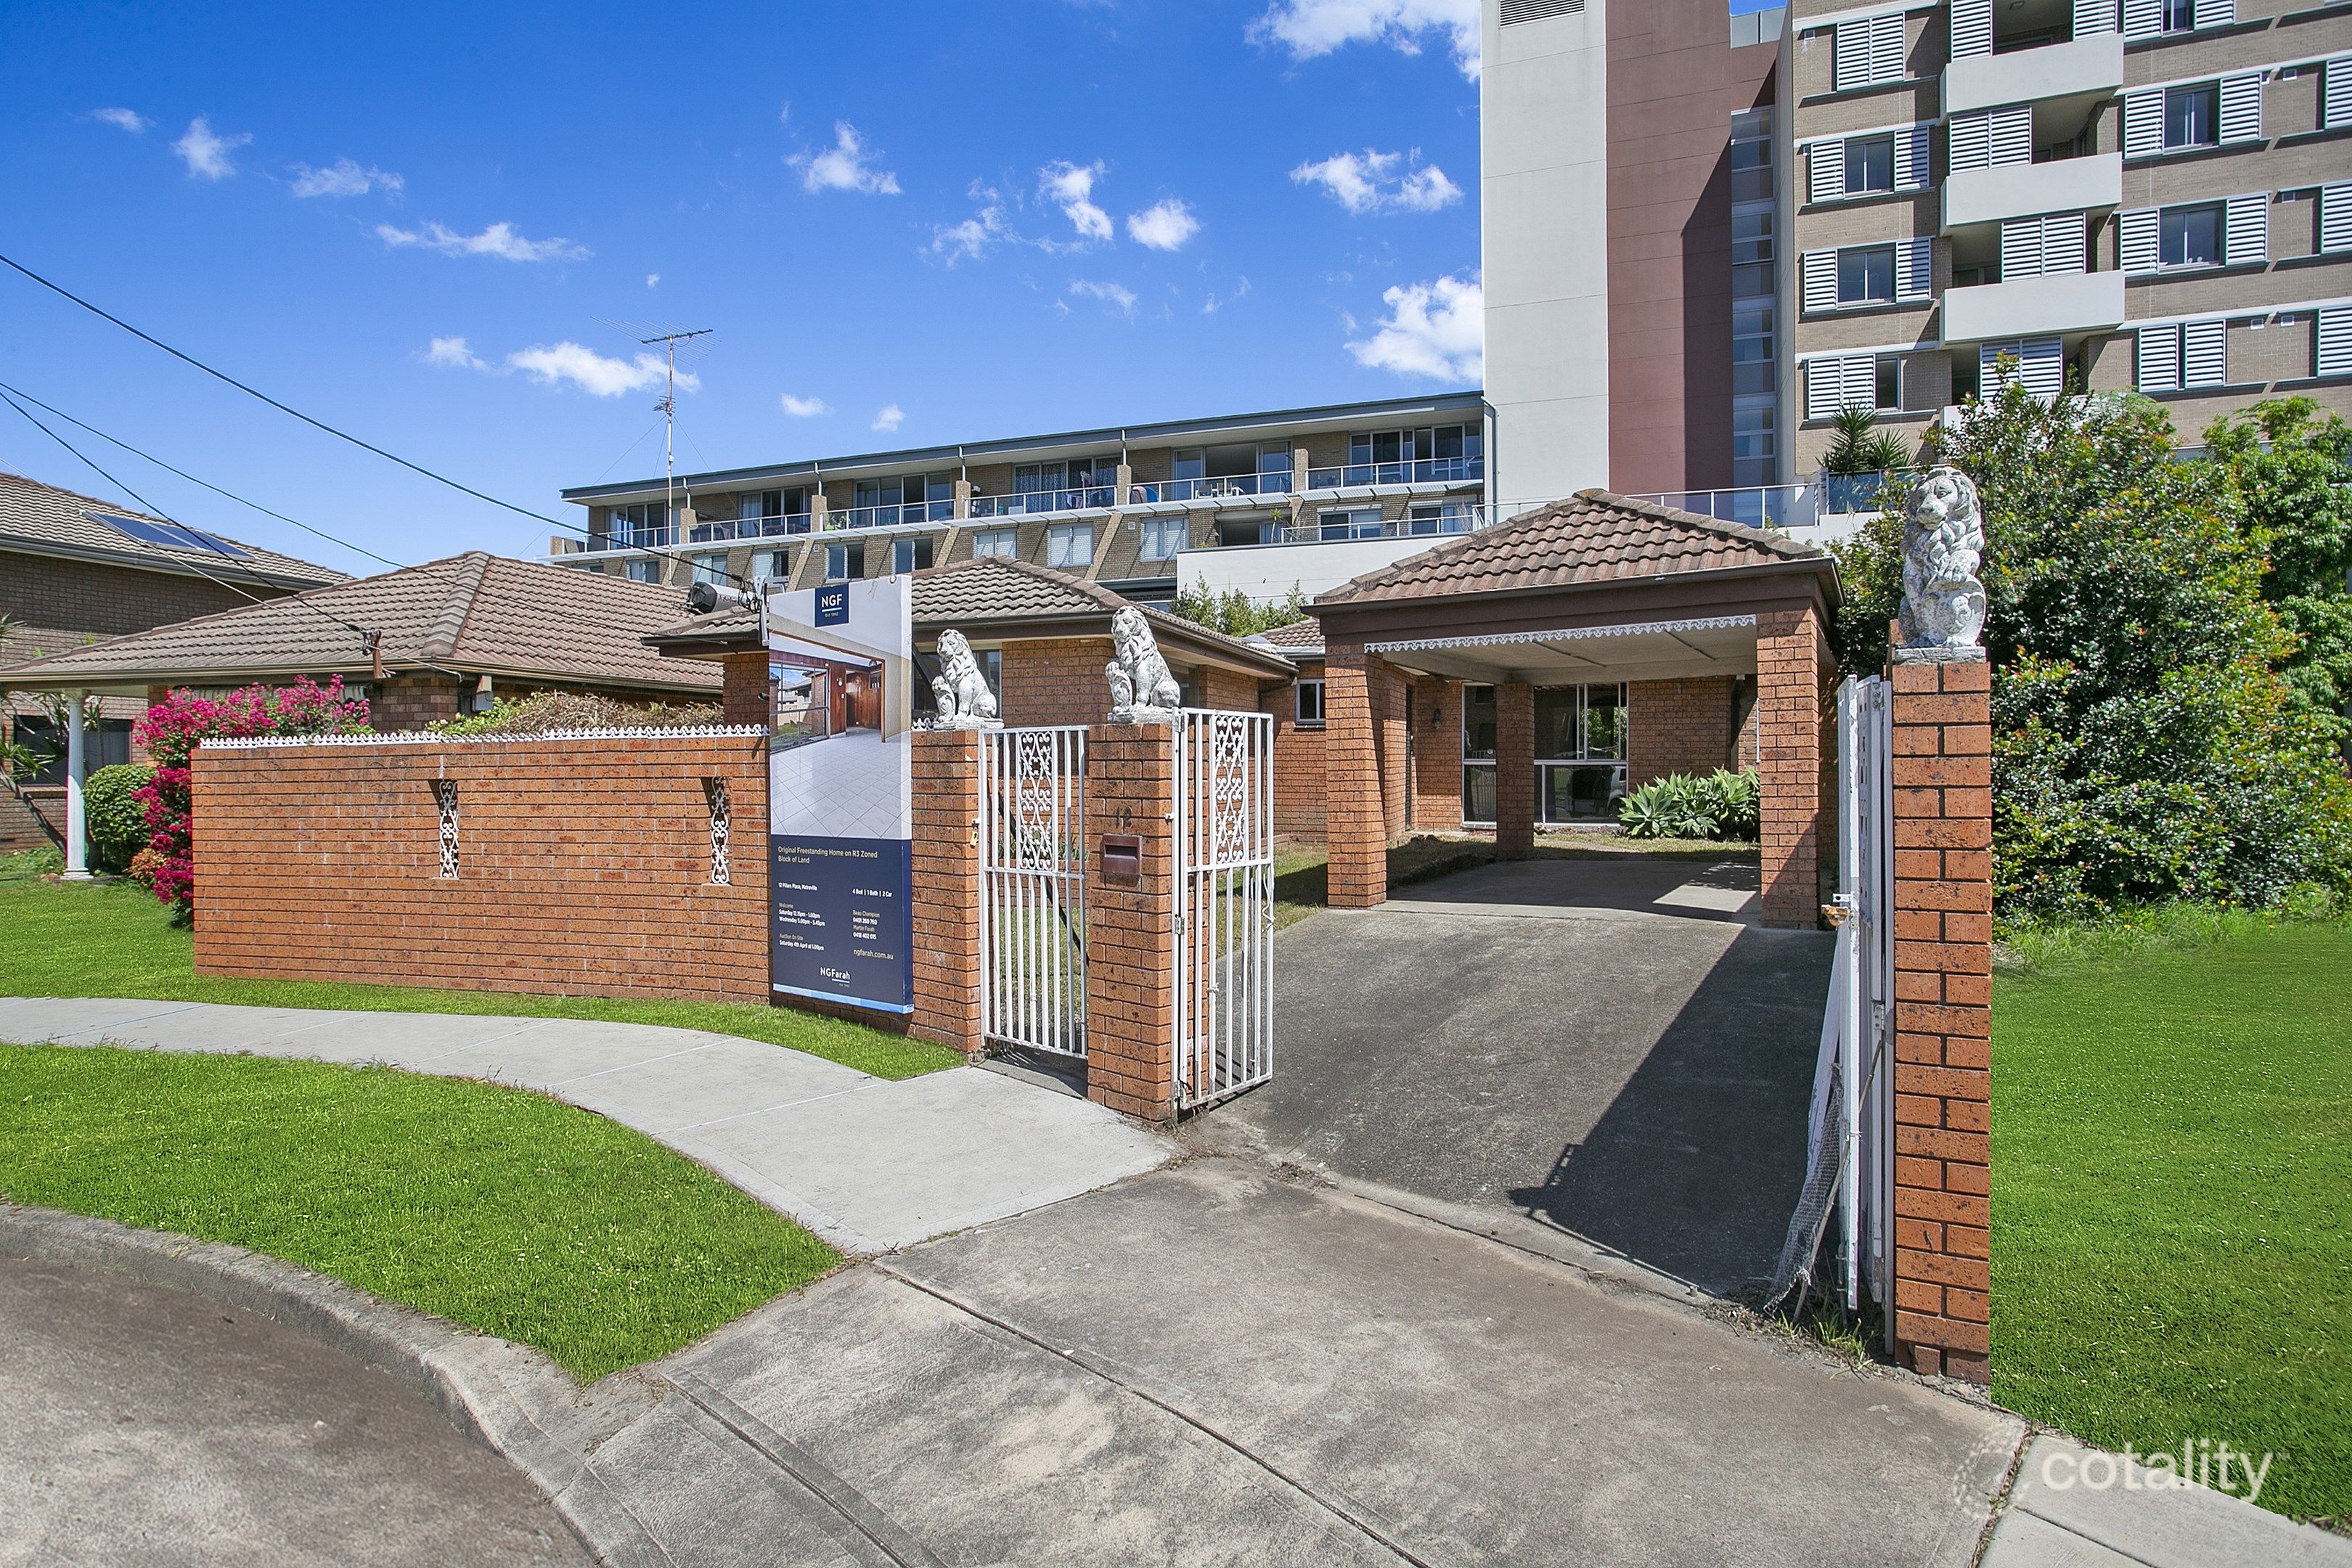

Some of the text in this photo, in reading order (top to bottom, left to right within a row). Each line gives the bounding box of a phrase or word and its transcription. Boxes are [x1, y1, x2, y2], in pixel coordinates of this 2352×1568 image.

[822, 593, 842, 608] NGF
[1115, 805, 1132, 828] 12
[777, 846, 796, 854] Original
[797, 847, 828, 856] Freestanding
[853, 948, 894, 960] ngfarah.com.au
[820, 967, 850, 980] NGFarah
